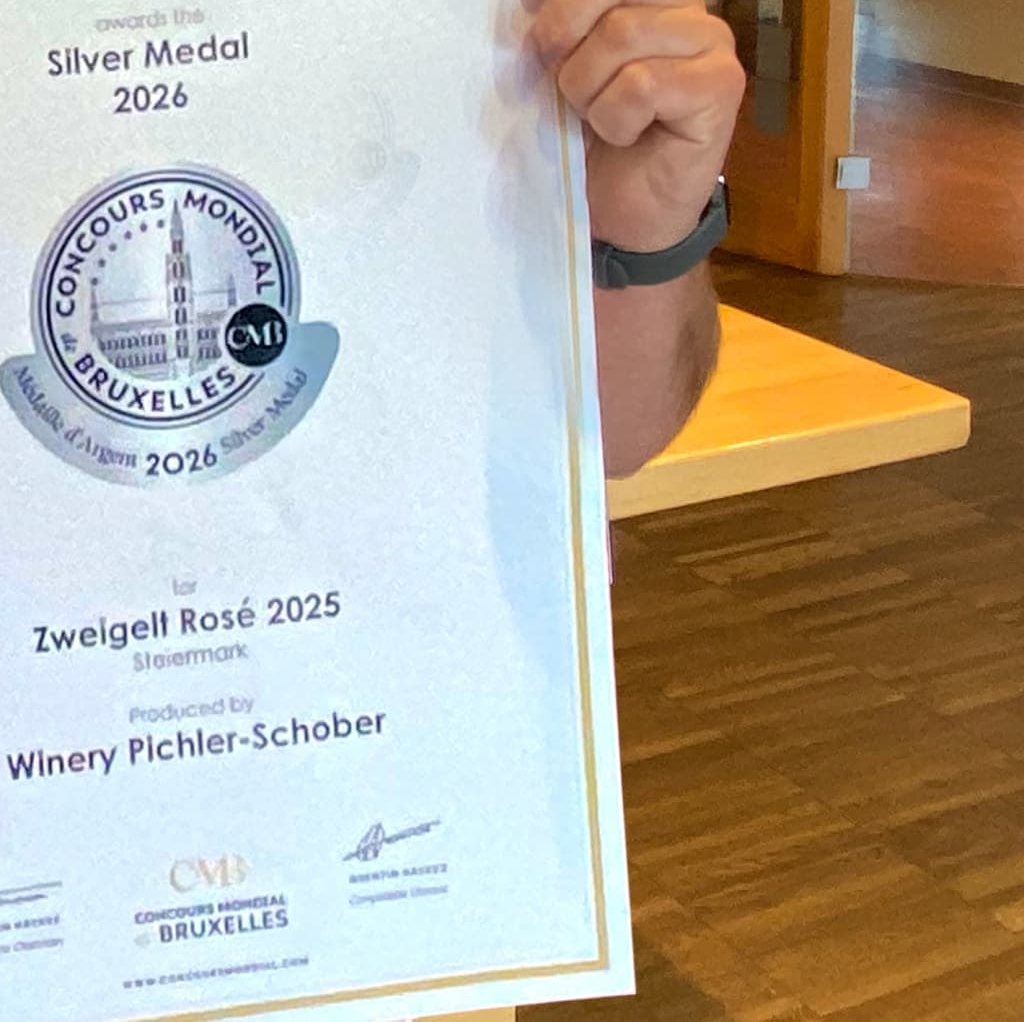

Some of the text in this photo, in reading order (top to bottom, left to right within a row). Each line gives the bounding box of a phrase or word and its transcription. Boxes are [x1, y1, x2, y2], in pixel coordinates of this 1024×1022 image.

[96, 7, 205, 32] awards the
[48, 31, 250, 76] Silver Medal
[113, 81, 189, 114] 2026
[56, 189, 275, 317] CONCOURS MONDIAL
[74, 355, 236, 412] BRUXELLES
[221, 418, 265, 455] Silver
[146, 446, 217, 476] 2026
[33, 591, 341, 653] Zweigelt Rosé 2025
[129, 695, 255, 724] Produced by
[7, 711, 387, 780] Winery Pichler-Schober
[134, 903, 214, 925] CONCOURS
[160, 909, 289, 944] BRUXELLES
